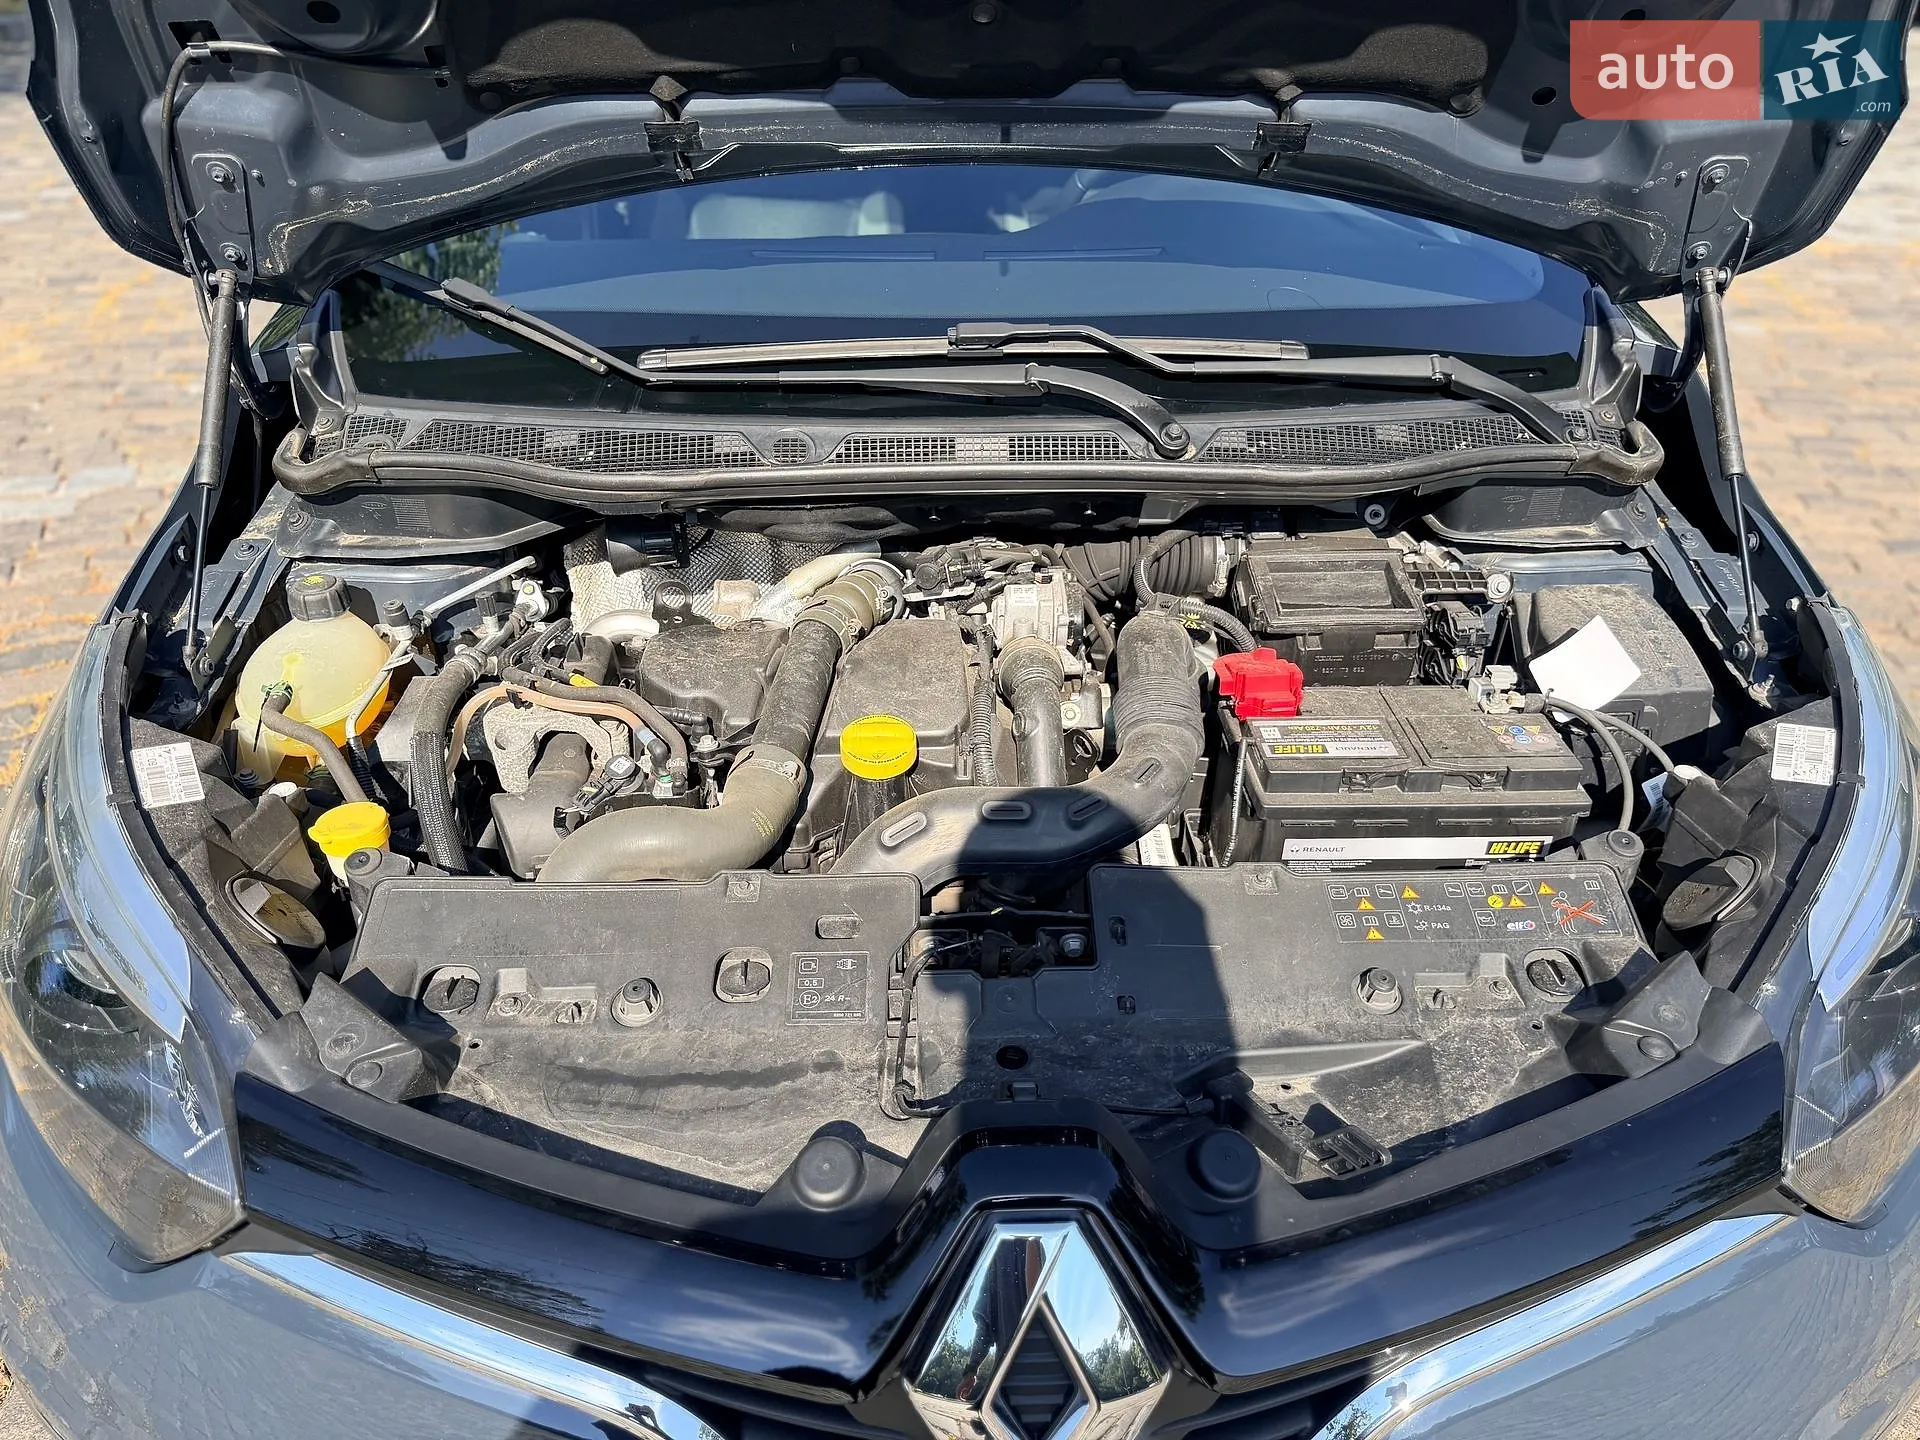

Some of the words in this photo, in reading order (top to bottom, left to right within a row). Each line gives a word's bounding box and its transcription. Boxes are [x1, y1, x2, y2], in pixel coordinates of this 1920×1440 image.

[1274, 744, 1323, 754] HI-LIFE
[1488, 841, 1541, 854] HI-LIFE
[1423, 904, 1452, 912] R-134a
[803, 994, 818, 1005] E2
